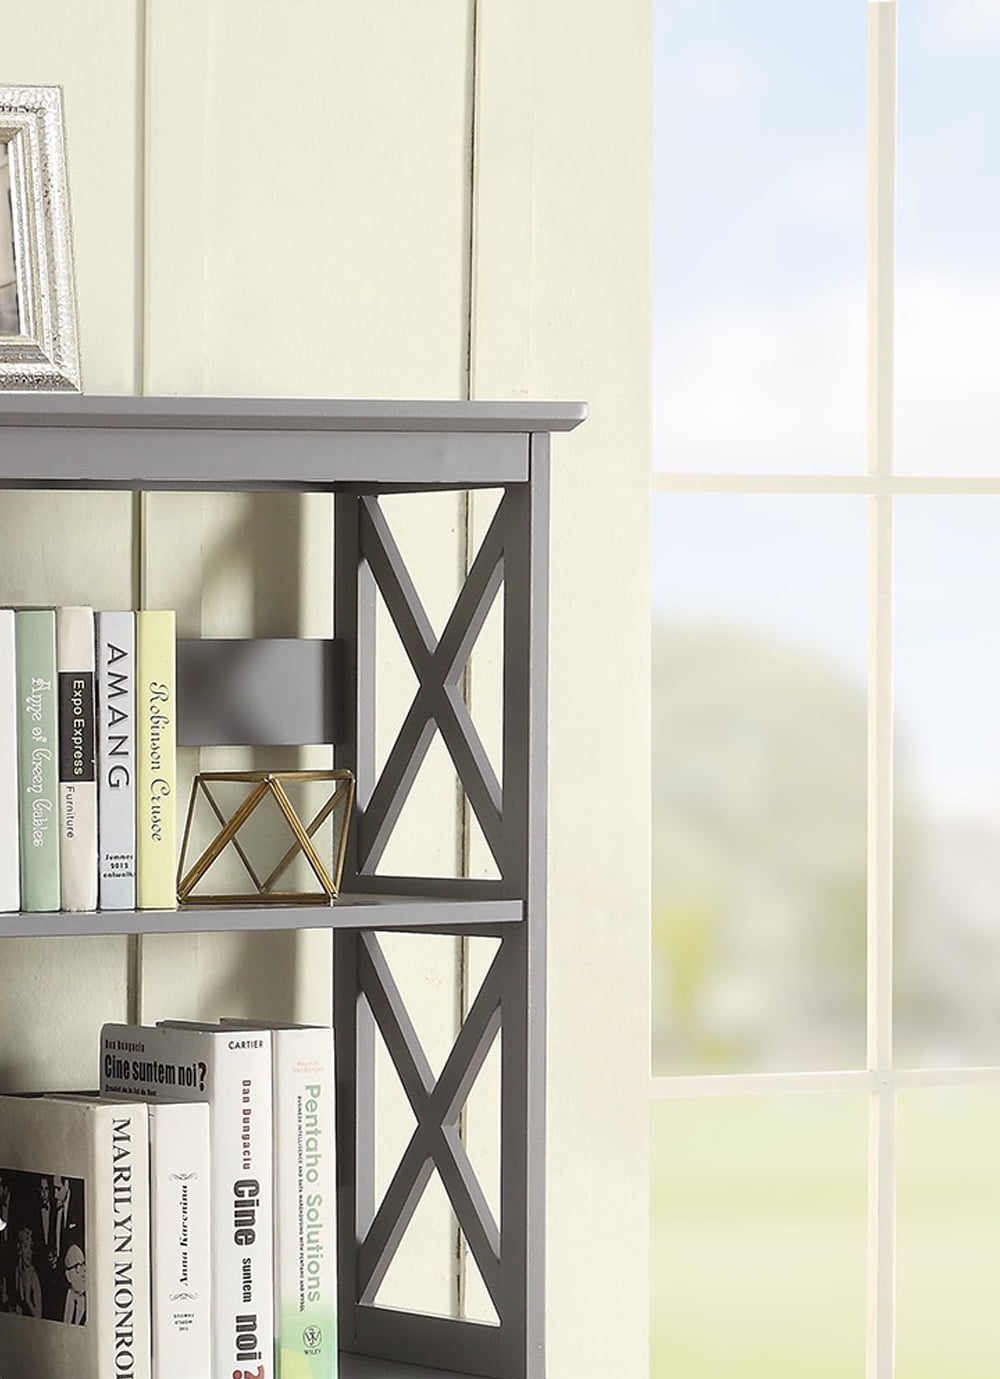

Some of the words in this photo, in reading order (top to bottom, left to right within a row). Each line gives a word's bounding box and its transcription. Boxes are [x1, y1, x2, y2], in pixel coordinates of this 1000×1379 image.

[71, 680, 85, 715] Expo
[107, 643, 130, 787] AMANG
[71, 719, 85, 775] Express
[149, 682, 170, 770] Robinson
[27, 748, 52, 793] Green
[32, 798, 53, 847] Gables
[66, 786, 75, 838] Furniture
[151, 778, 171, 841] Crusoe
[104, 1054, 130, 1080] Cine
[132, 1061, 176, 1085] suntem
[178, 1061, 207, 1092] noi?
[228, 1040, 263, 1050] CARTIER
[242, 1079, 251, 1103] Dan
[241, 1108, 252, 1170] Dungaciu
[305, 1085, 322, 1182] Pentaho
[112, 1118, 133, 1253] MARILYN
[233, 1179, 260, 1246] Cine
[179, 1185, 188, 1247] Karenina
[179, 1252, 188, 1287] Anna
[306, 1194, 323, 1302] Solutions
[242, 1258, 253, 1303] suntem
